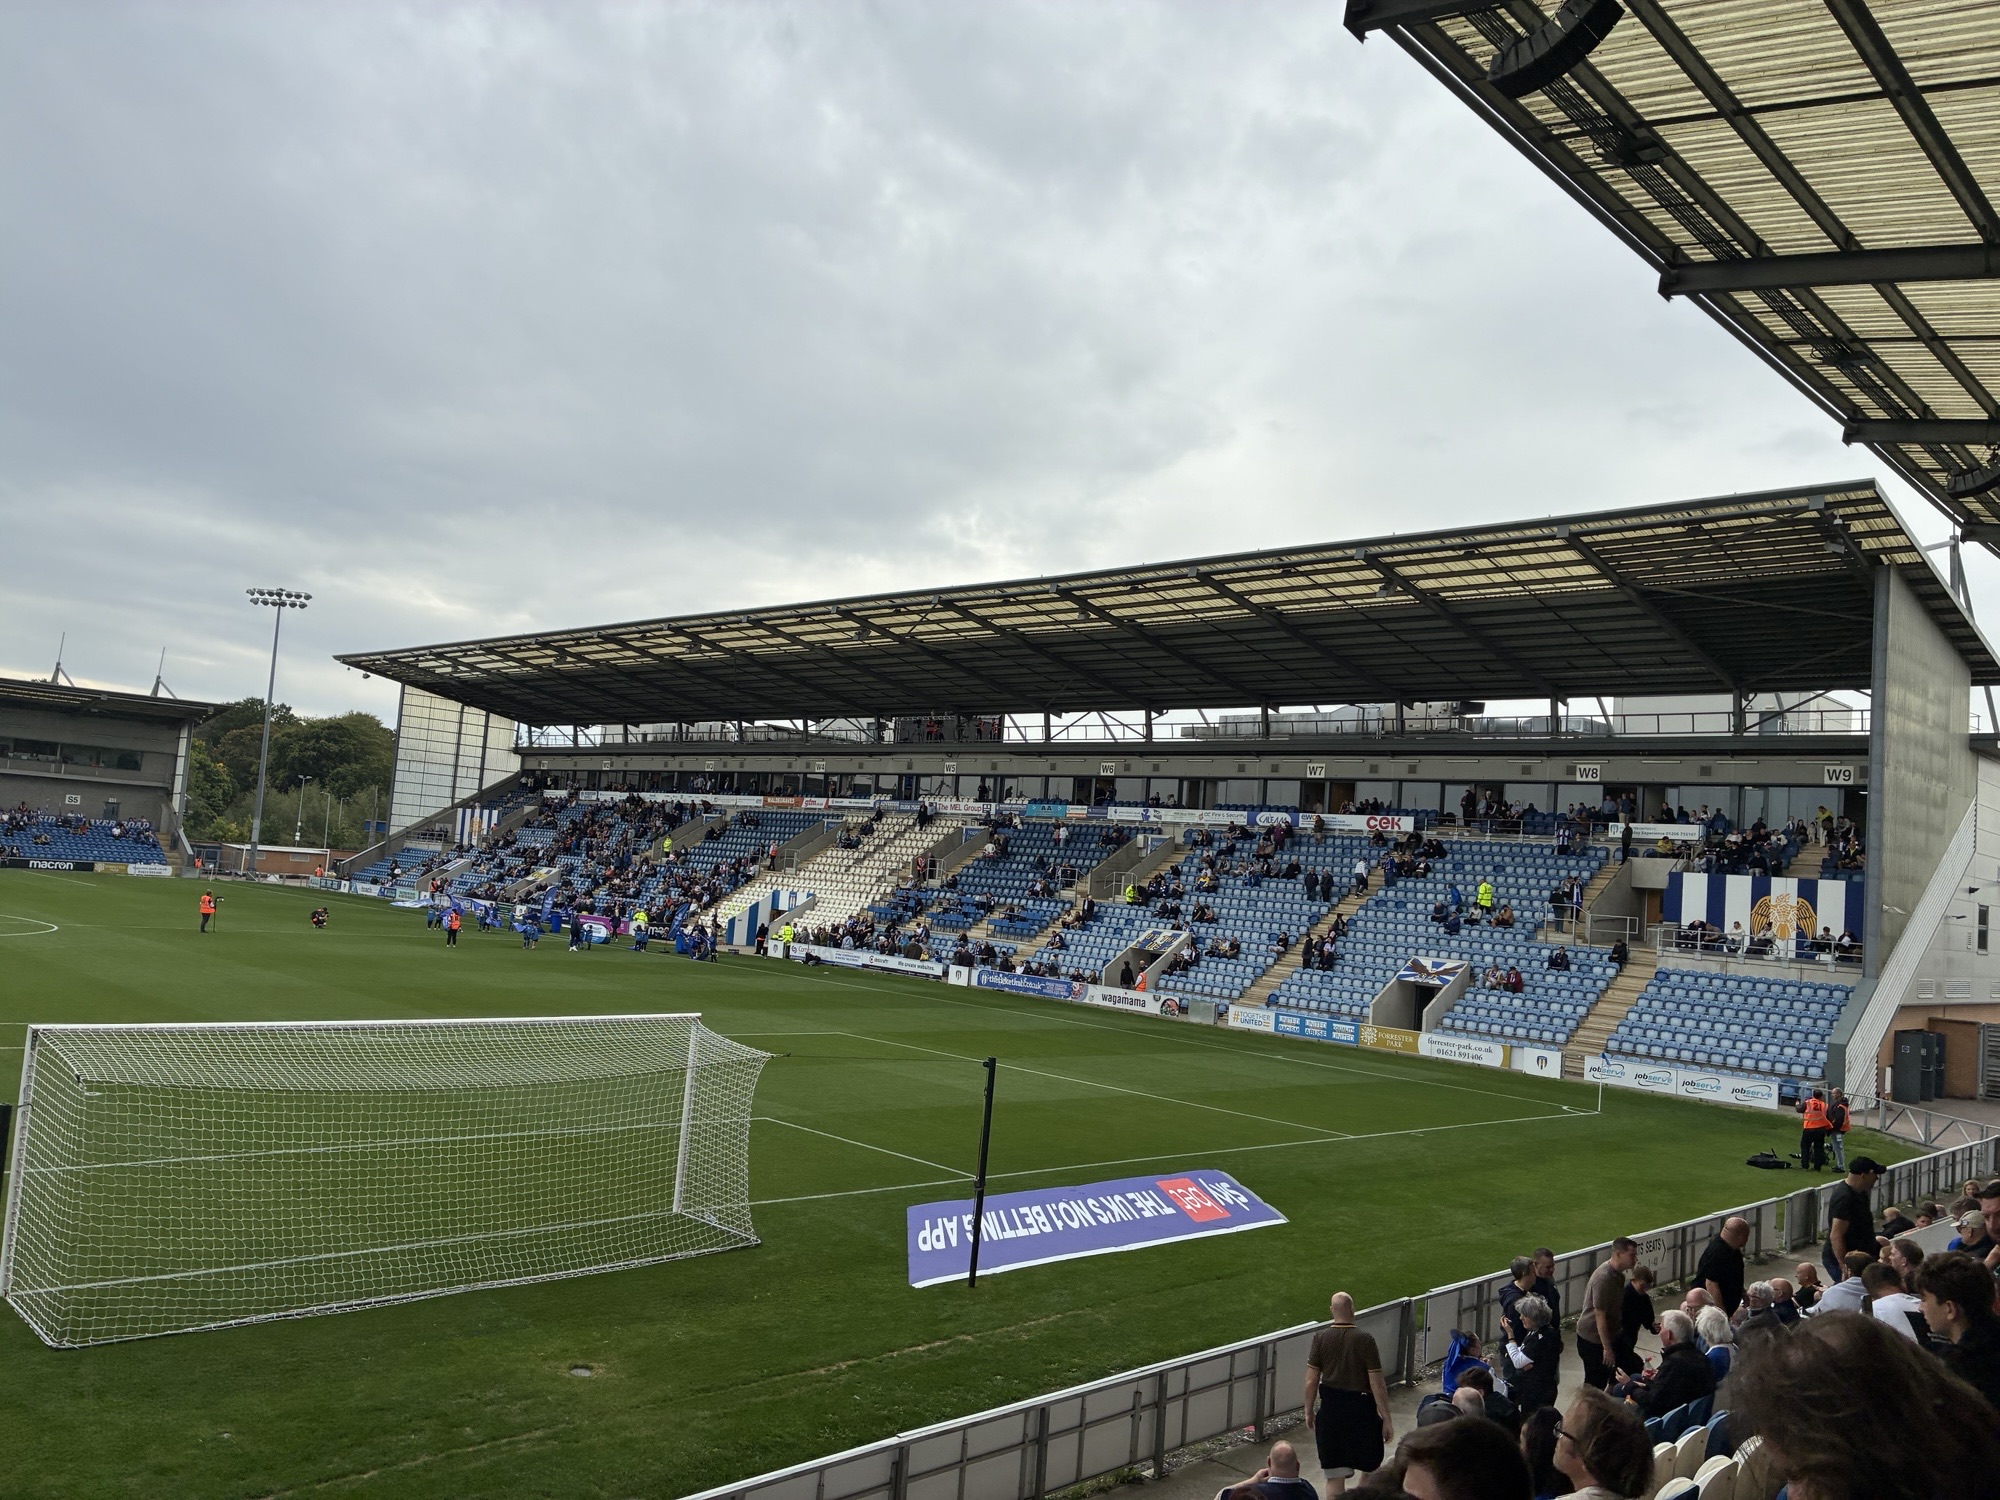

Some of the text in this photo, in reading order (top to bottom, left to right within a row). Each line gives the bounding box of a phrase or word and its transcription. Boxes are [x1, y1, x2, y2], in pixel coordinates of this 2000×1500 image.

[815, 763, 825, 771] W4
[945, 764, 956, 773] W5
[1101, 764, 1114, 774] W6
[1308, 765, 1324, 776] W7
[1578, 767, 1599, 779] W8
[1826, 768, 1852, 782] W9
[67, 796, 79, 804] S5
[938, 803, 982, 813] The MEL Group
[29, 860, 74, 870] macron
[1101, 993, 1147, 1008] wagamama
[1240, 1018, 1263, 1027] UNITED
[1305, 1028, 1327, 1037] ABUSE
[1378, 1031, 1414, 1043] FORRESTER
[1386, 1040, 1403, 1048] PARK
[1427, 1037, 1494, 1054] forrester-park.co.uk
[1436, 1048, 1483, 1061] 01621 891406
[1589, 1066, 1626, 1077] jobserve
[1634, 1072, 1673, 1084] jobserve
[1682, 1079, 1722, 1091] jobserve
[1731, 1087, 1773, 1099] jobserve
[1813, 1102, 1822, 1112] 21
[1169, 1177, 1250, 1214] sky bet
[1124, 1189, 1177, 1218] THE
[1087, 1194, 1141, 1226] UK'S
[962, 1204, 1054, 1243] BETTING
[917, 1215, 958, 1252] APP
[1645, 1238, 1662, 1253] SEATS
